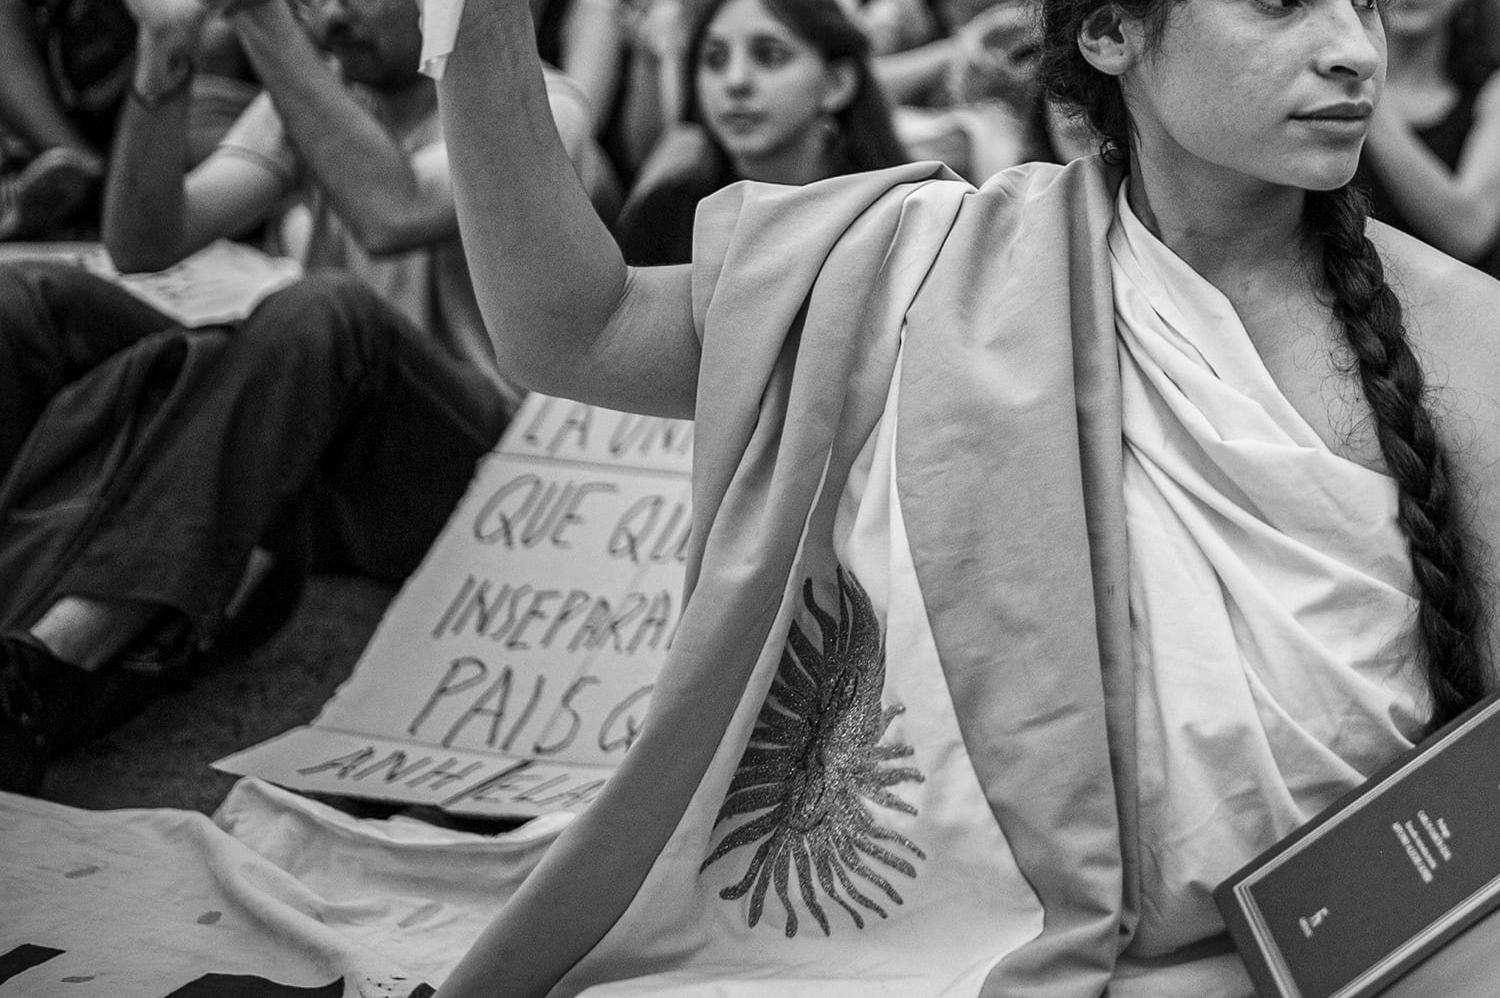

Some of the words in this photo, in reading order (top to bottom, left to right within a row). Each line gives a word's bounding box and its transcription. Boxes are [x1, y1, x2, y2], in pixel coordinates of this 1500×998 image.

[474, 472, 621, 551] QUE
[433, 574, 684, 652] INSEPARA
[408, 655, 600, 757] PAIS
[297, 746, 608, 808] ANHELA
